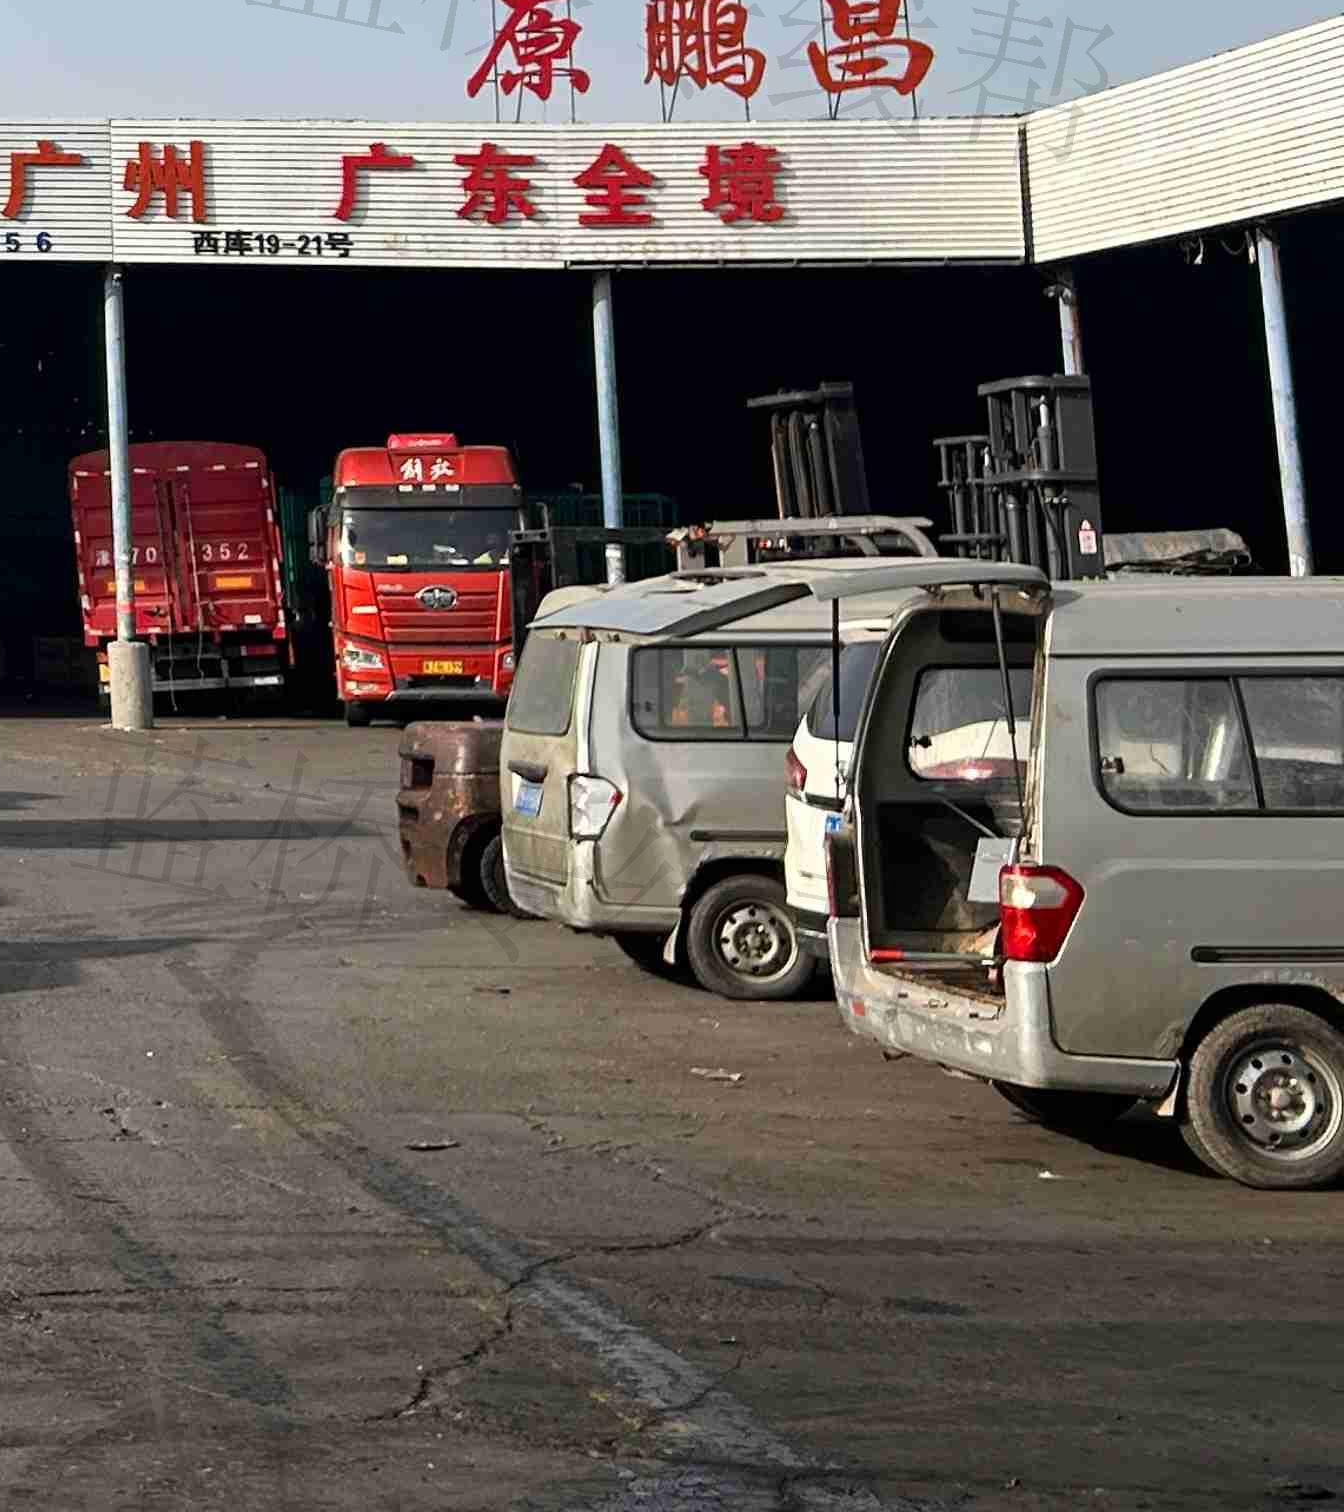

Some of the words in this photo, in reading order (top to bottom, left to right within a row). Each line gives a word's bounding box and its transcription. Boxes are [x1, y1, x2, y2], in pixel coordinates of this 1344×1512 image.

[2, 139, 208, 221] 广州
[333, 141, 786, 227] 广东全境
[192, 230, 354, 258] 西库19-21号
[201, 543, 249, 562] 352
